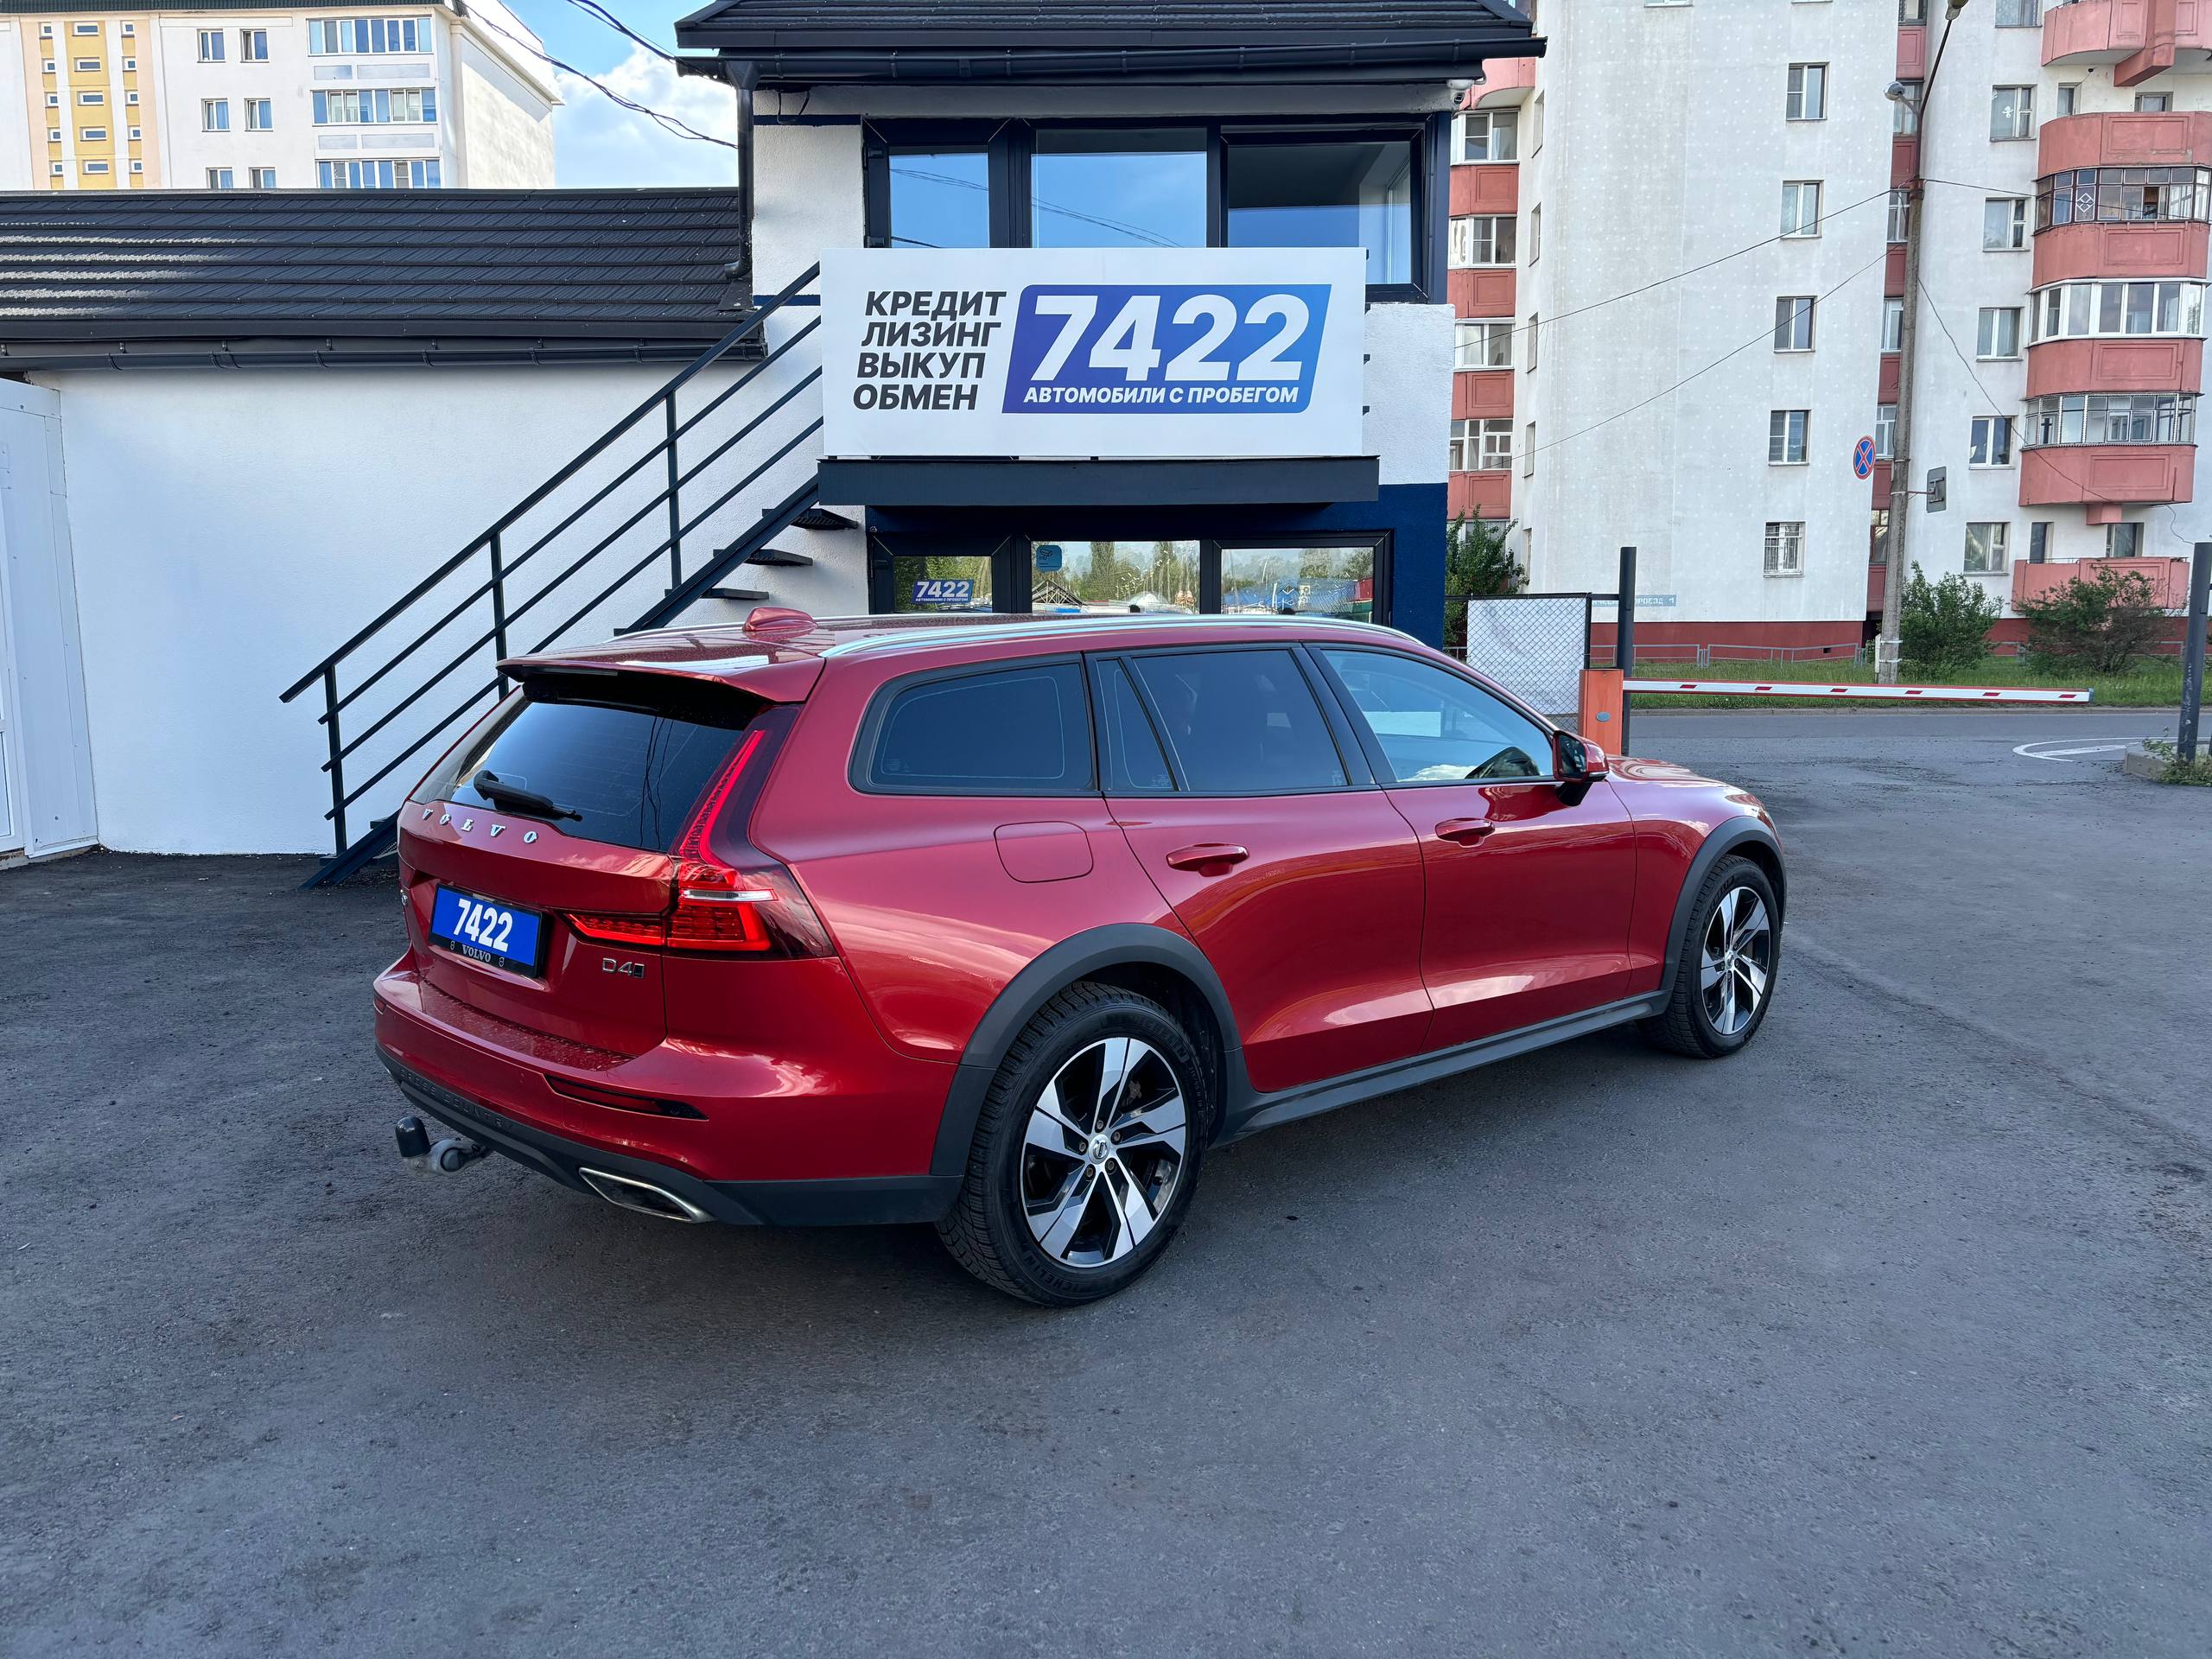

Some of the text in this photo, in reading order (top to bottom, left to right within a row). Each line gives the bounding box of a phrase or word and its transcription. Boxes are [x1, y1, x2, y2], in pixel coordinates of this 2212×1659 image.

[865, 291, 1007, 321] КРЕДИТ
[861, 321, 1001, 346] ЛИЗИНГ
[1031, 294, 1309, 381] 7422
[857, 353, 986, 378] ВЫКУП
[853, 384, 978, 410] ОБМЕН
[1024, 386, 1299, 403] АВТОМОБИЛИ С ПРОБЕГОМ
[917, 582, 969, 597] 7422
[422, 809, 538, 844] VOLVO
[454, 898, 513, 952] 7422
[461, 944, 492, 963] VOLVO
[602, 957, 632, 976] D4
